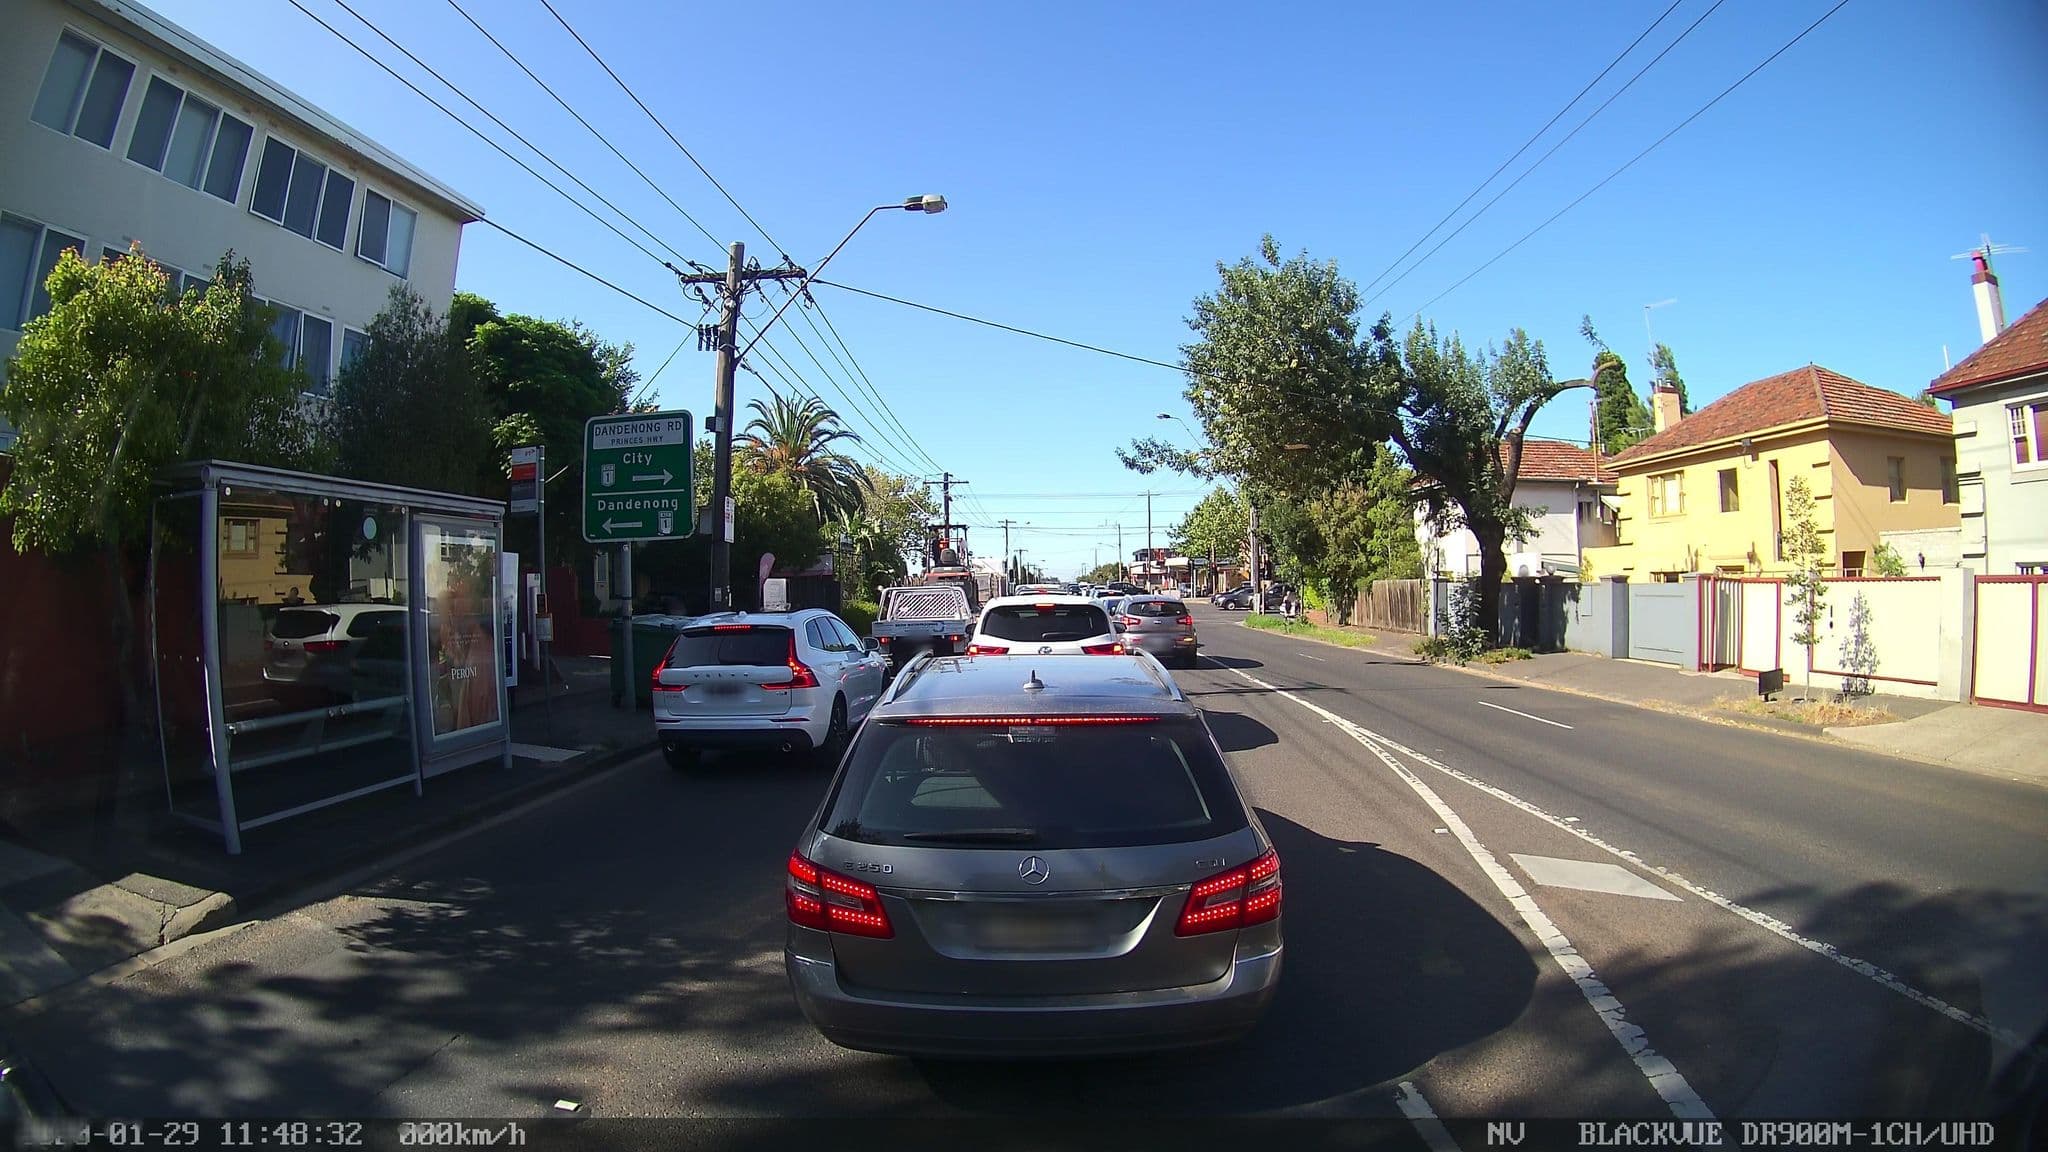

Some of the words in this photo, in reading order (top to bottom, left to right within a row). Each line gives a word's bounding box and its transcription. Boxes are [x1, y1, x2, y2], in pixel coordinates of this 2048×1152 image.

[594, 422, 661, 437] DANDENONG
[667, 420, 682, 432] RD
[611, 437, 644, 446] PRINCES
[647, 435, 664, 444] HWY
[623, 452, 653, 466] City
[598, 498, 678, 511] Dandenong
[451, 667, 477, 680] PERONI
